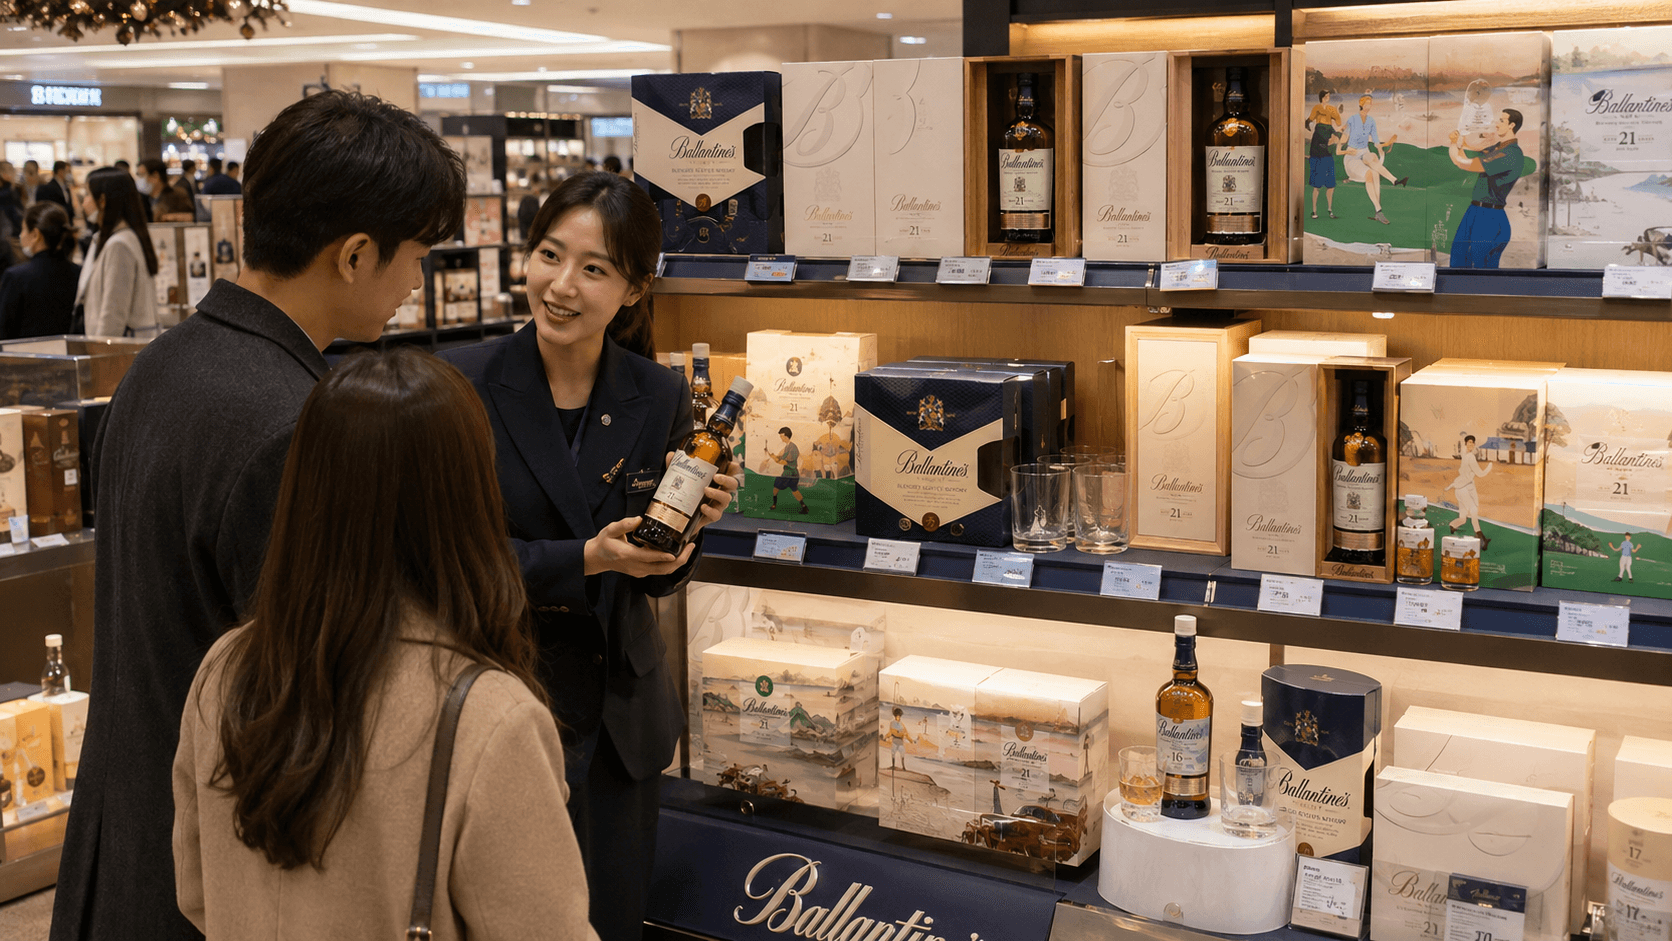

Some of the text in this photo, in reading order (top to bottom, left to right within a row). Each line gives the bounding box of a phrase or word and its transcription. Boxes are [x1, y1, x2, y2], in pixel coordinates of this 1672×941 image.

[1619, 131, 1636, 145] 21
[669, 135, 736, 159] Ballantine's
[889, 193, 942, 212] Ballantine's
[1015, 196, 1024, 205] 21
[1224, 197, 1234, 206] 21
[804, 204, 853, 221] Ballantine's
[1096, 204, 1152, 222] Ballantine's
[909, 225, 919, 235] 21
[822, 233, 832, 242] 21
[1117, 234, 1128, 243] 21
[789, 402, 798, 412] 21
[1580, 441, 1665, 469] Ballantine's
[894, 449, 969, 478] Ballantine's
[1150, 473, 1203, 493] Ballantine's
[1612, 482, 1629, 495] 21
[1170, 508, 1180, 518] 21
[1348, 514, 1358, 523] 21
[1245, 513, 1302, 534] Ballantine's
[1267, 545, 1278, 554] 21
[759, 720, 769, 730] 21
[1172, 752, 1183, 762] 16
[1021, 768, 1030, 777] 21
[1279, 767, 1351, 809] Ballantine's
[1629, 846, 1642, 860] 17
[1423, 921, 1438, 936] 21
